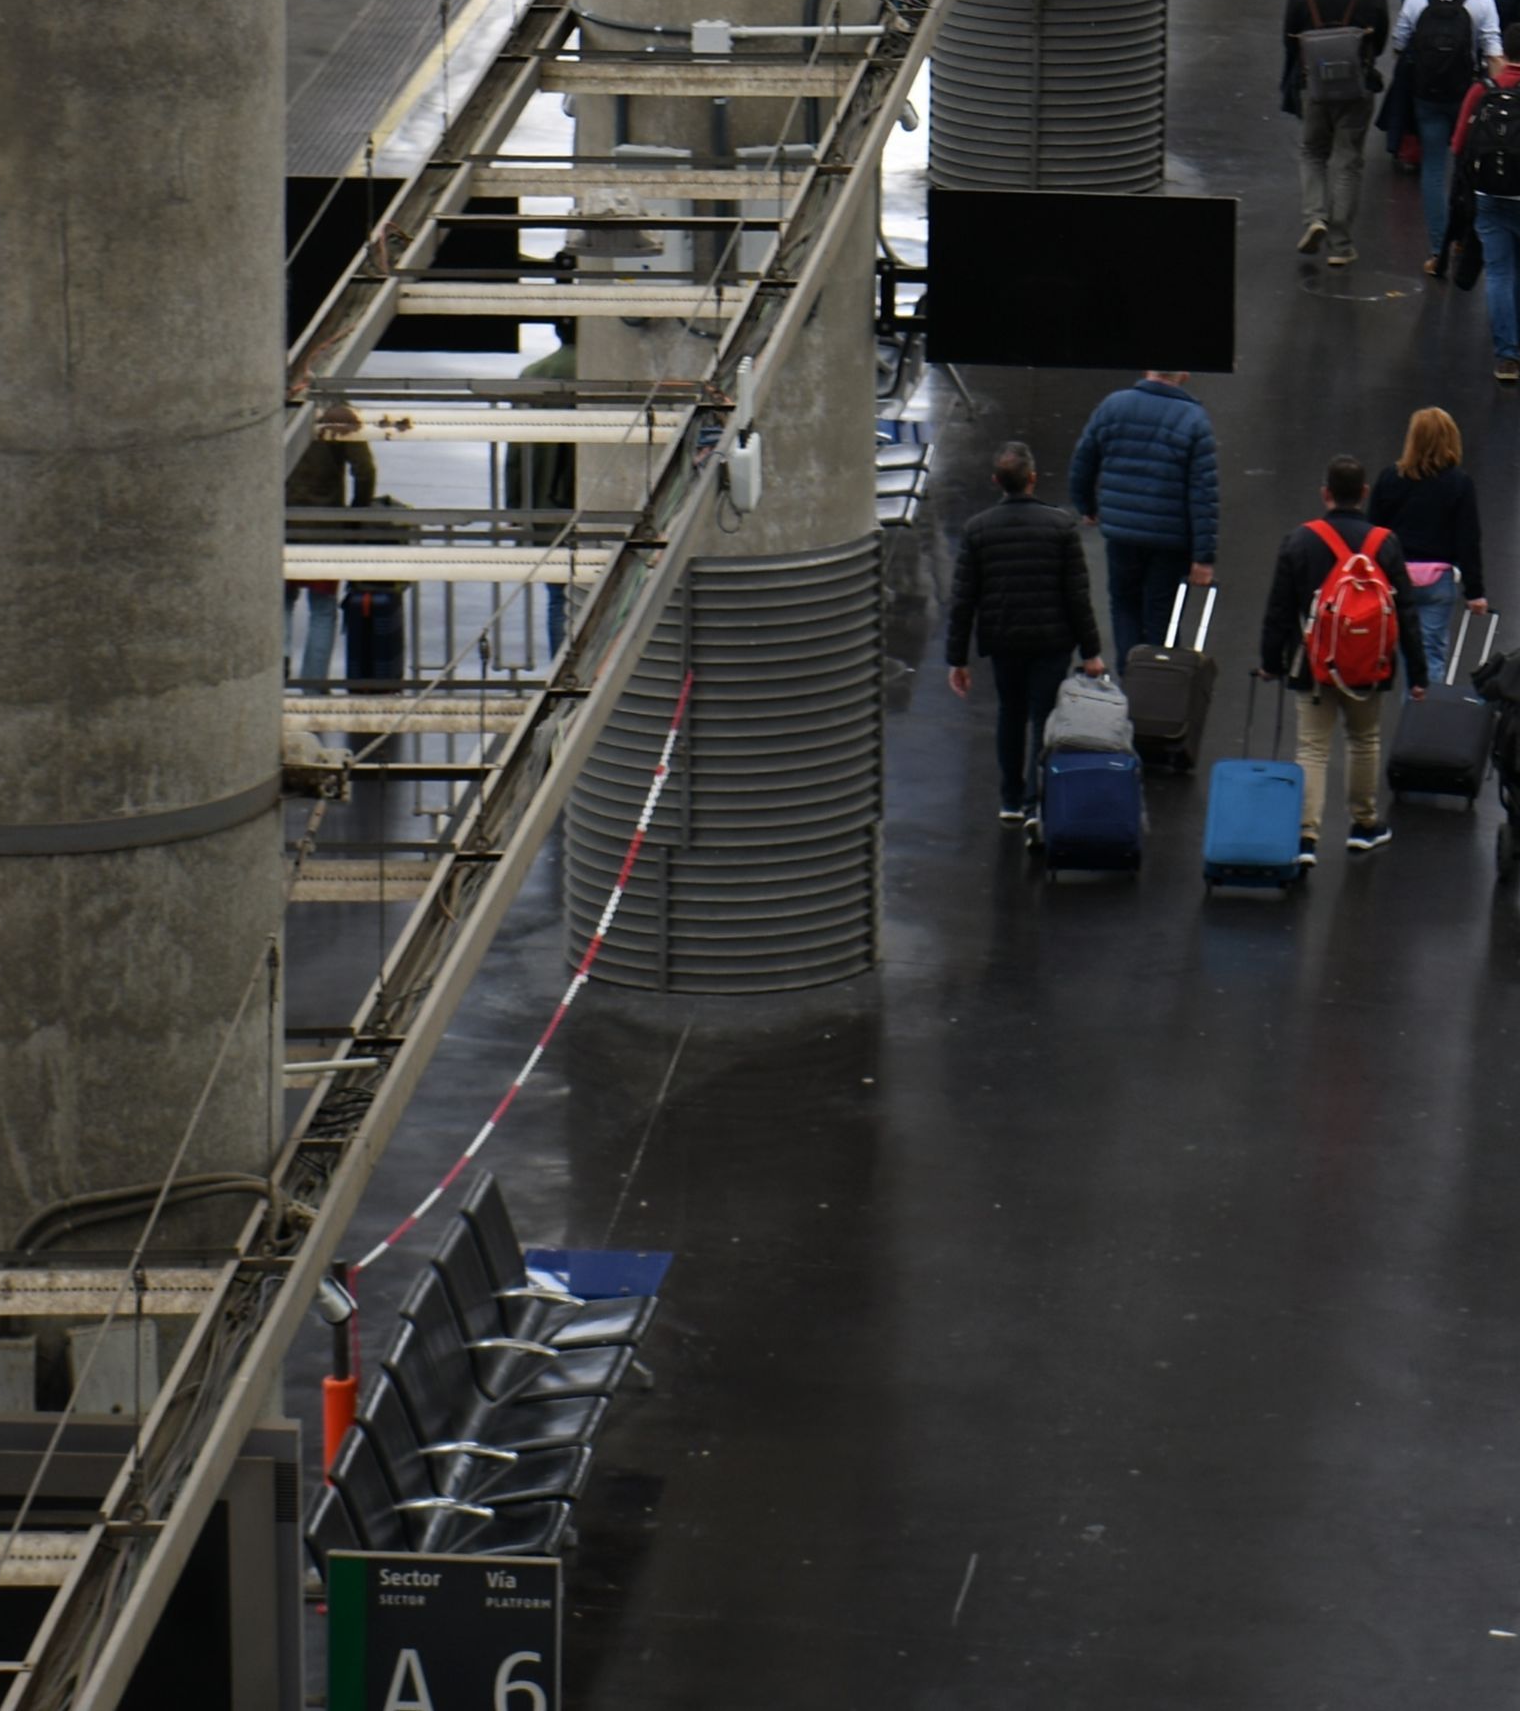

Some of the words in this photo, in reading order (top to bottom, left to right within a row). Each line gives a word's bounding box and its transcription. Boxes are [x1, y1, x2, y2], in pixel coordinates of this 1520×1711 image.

[379, 1568, 442, 1587] Sector
[485, 1569, 517, 1589] Vía
[379, 1594, 426, 1606] SECTOR
[485, 1596, 552, 1609] PLATFORM
[384, 1648, 435, 1711] A
[494, 1651, 547, 1711] 6
